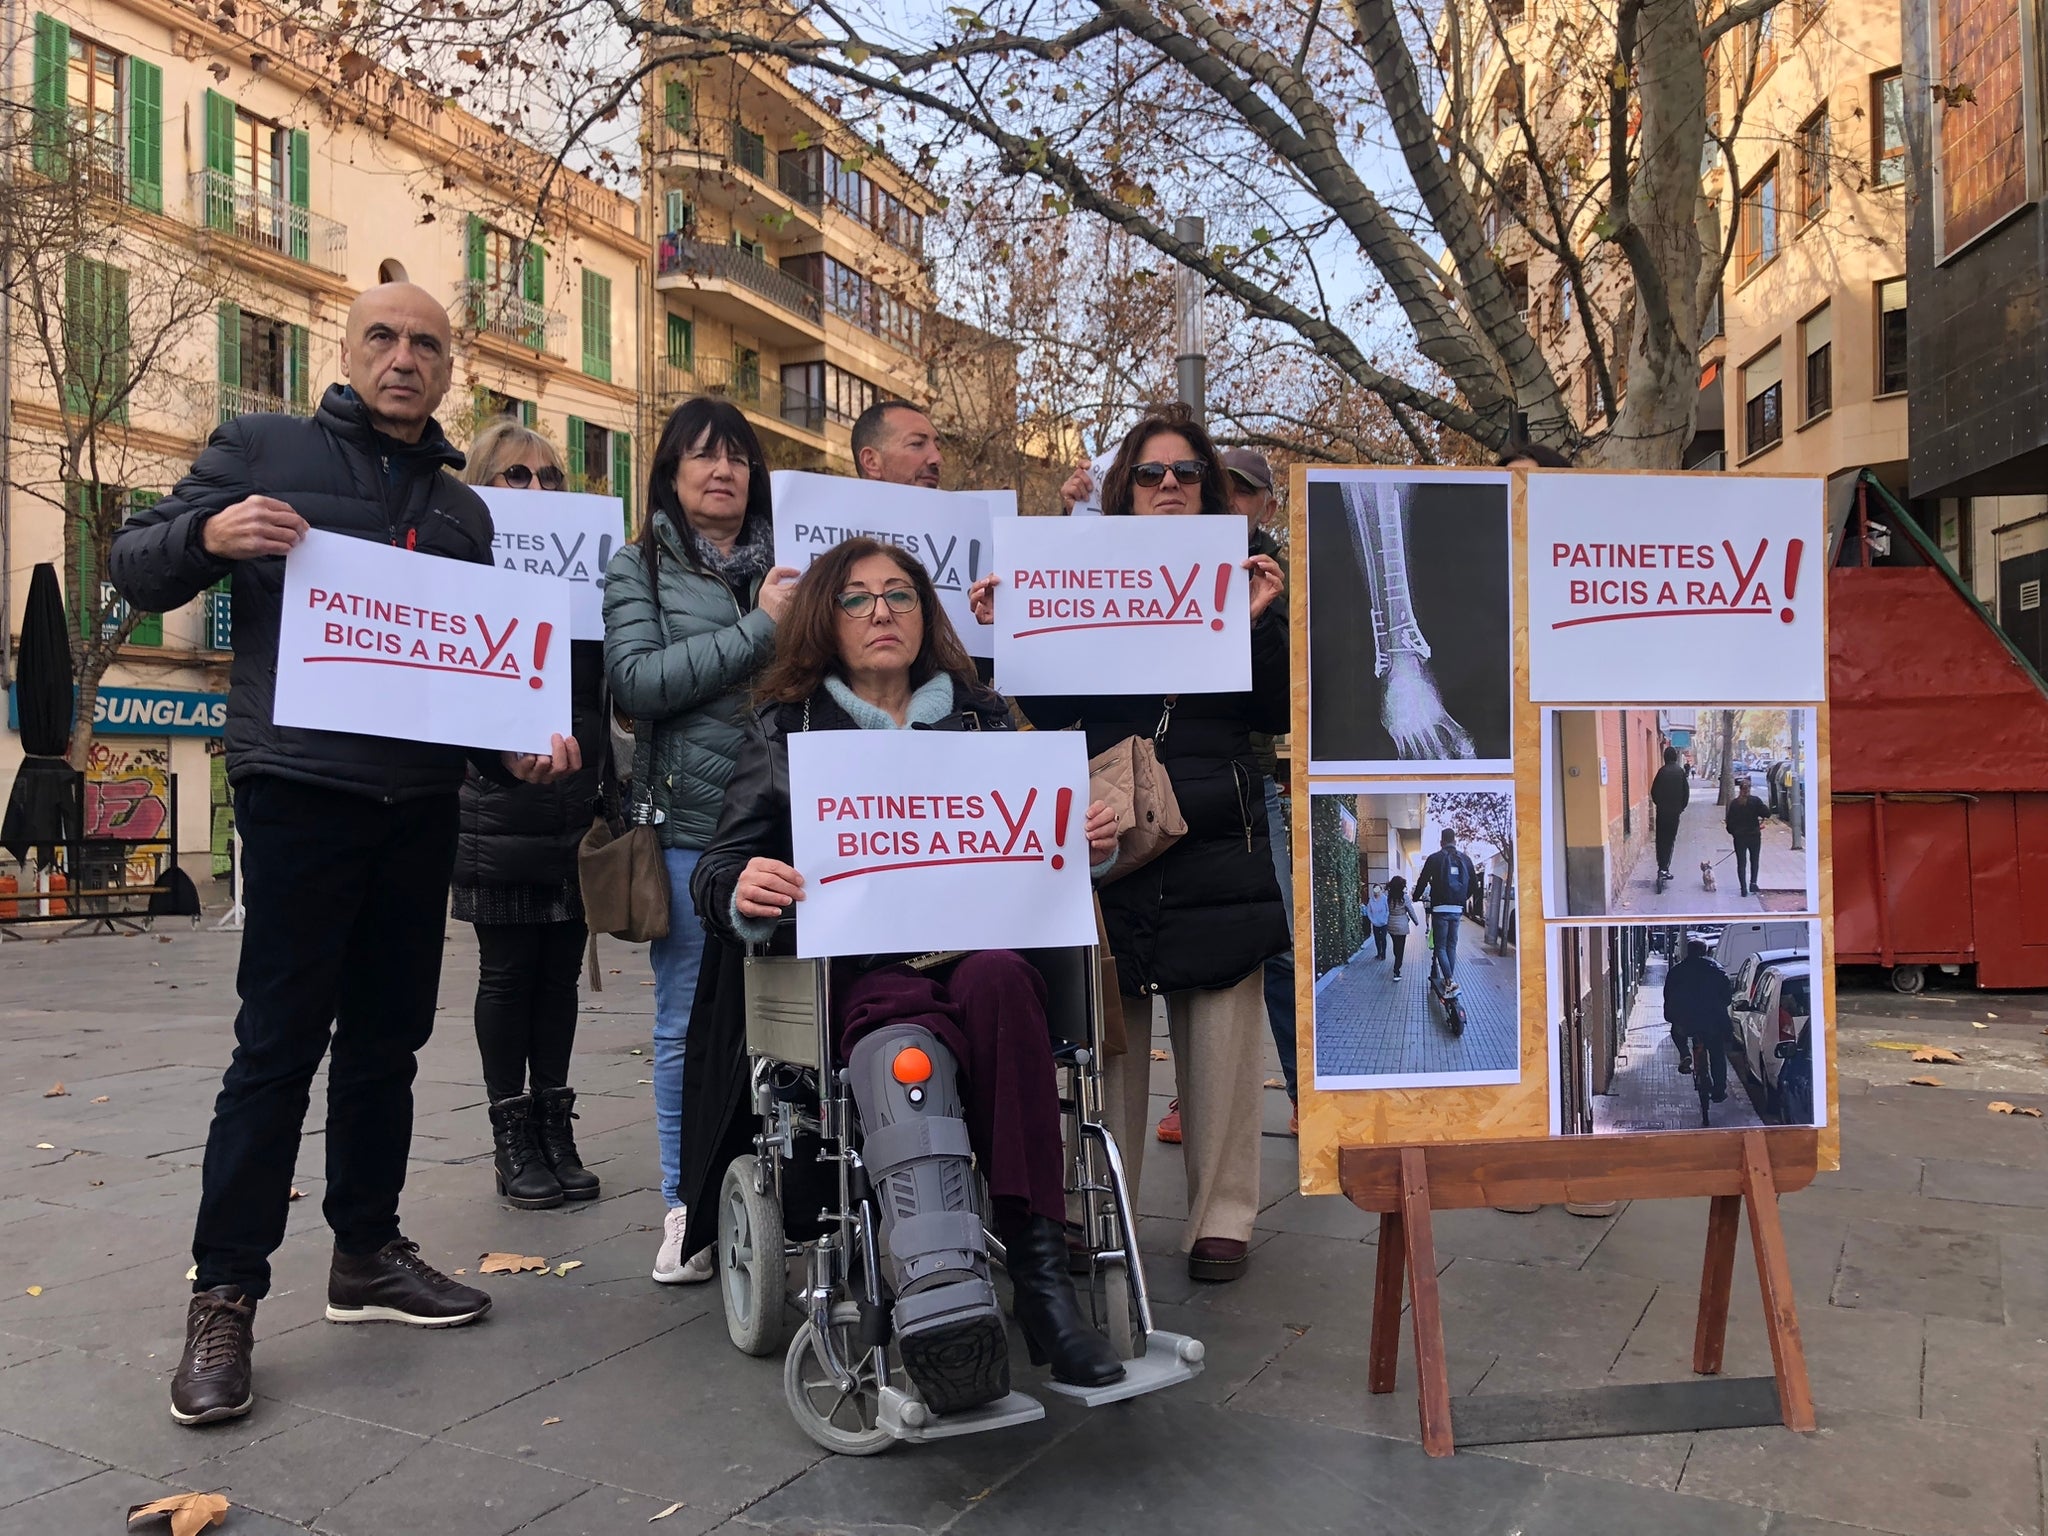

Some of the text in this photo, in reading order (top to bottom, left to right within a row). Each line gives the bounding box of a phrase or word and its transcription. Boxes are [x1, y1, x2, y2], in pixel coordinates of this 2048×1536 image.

[1553, 543, 1715, 570] PATINETES
[1014, 569, 1153, 589] PATINETES
[1570, 580, 1648, 605] BICIS
[1657, 582, 1678, 605] A
[309, 588, 468, 635] PATINETES
[1029, 599, 1095, 619] BICIS
[1103, 599, 1120, 617] A
[324, 622, 403, 655] BICIS
[410, 639, 429, 659] A
[94, 696, 227, 728] SUNGLAS
[817, 795, 985, 821] PATINETES
[837, 831, 920, 858] BICIS
[929, 831, 950, 856] A
